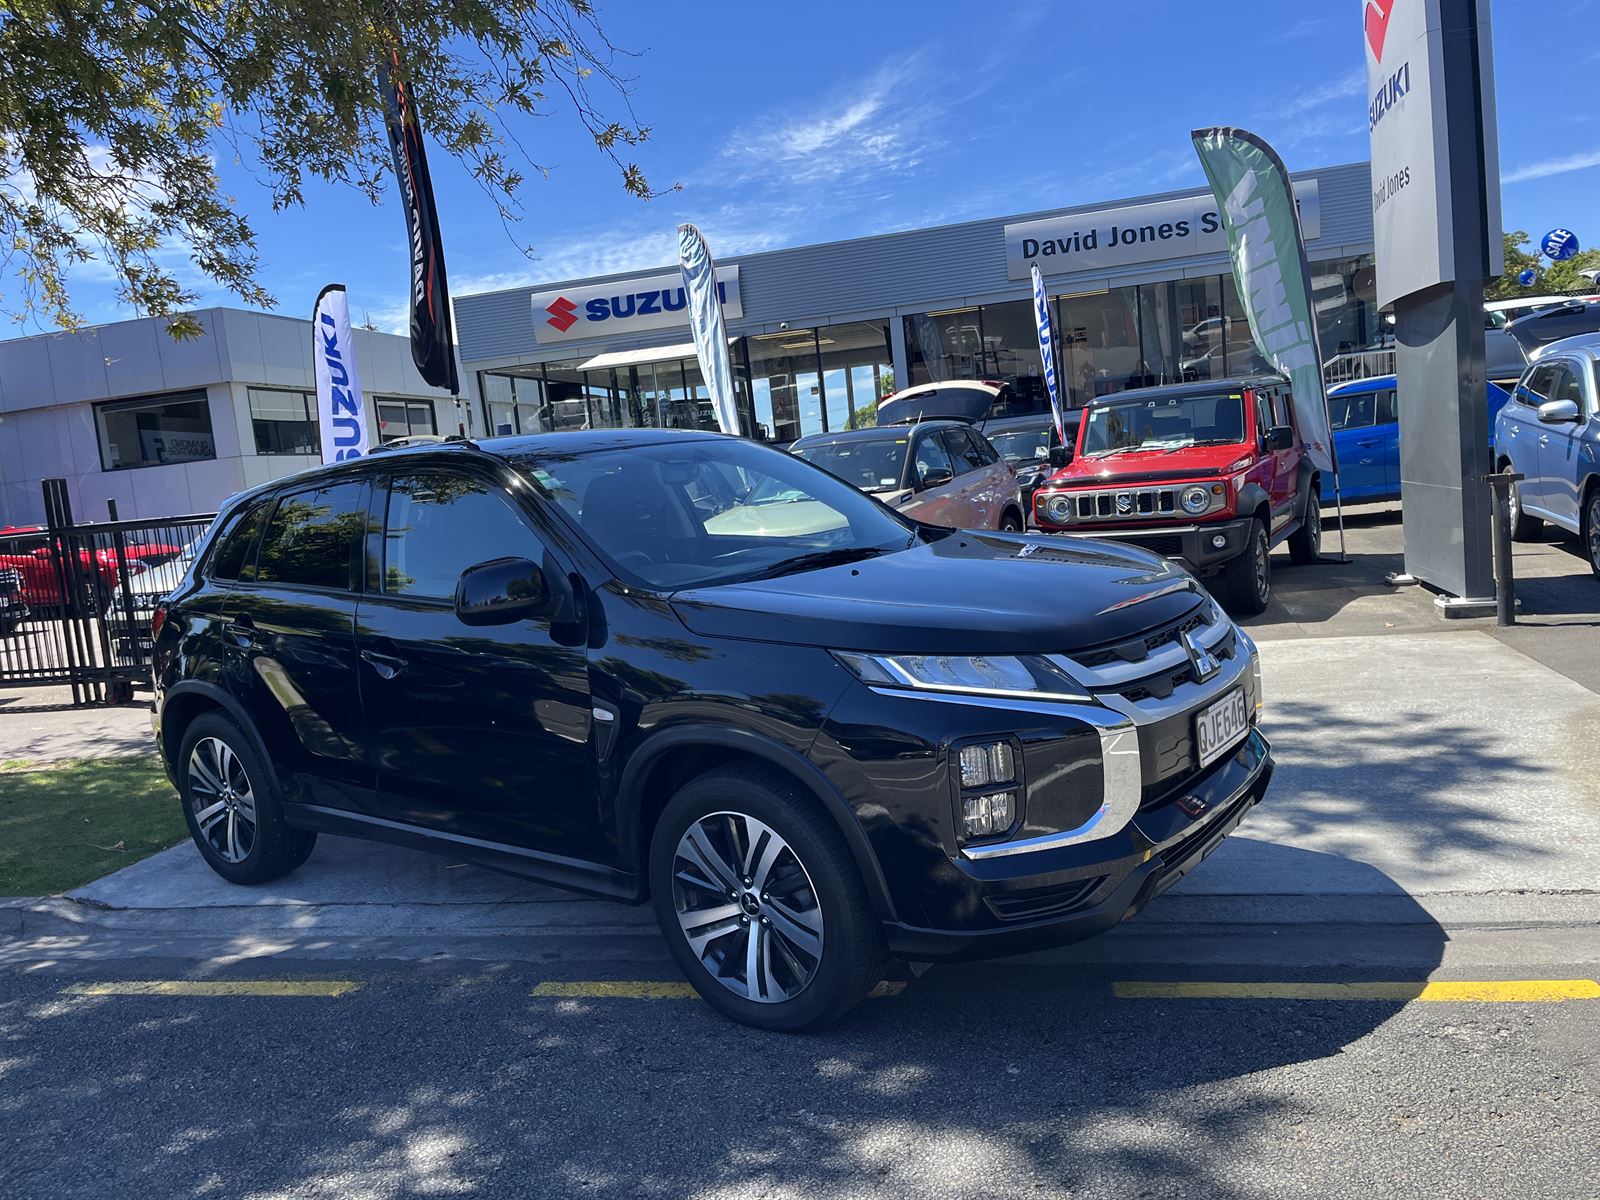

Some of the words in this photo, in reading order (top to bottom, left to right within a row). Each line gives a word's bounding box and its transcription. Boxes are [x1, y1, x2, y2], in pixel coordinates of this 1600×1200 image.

[1387, 166, 1410, 200] Jones
[1022, 229, 1098, 260] David
[1108, 217, 1190, 248] Jones
[1546, 229, 1572, 256] SALE
[585, 281, 727, 322] SUZUI
[1198, 696, 1246, 754] QJE646
